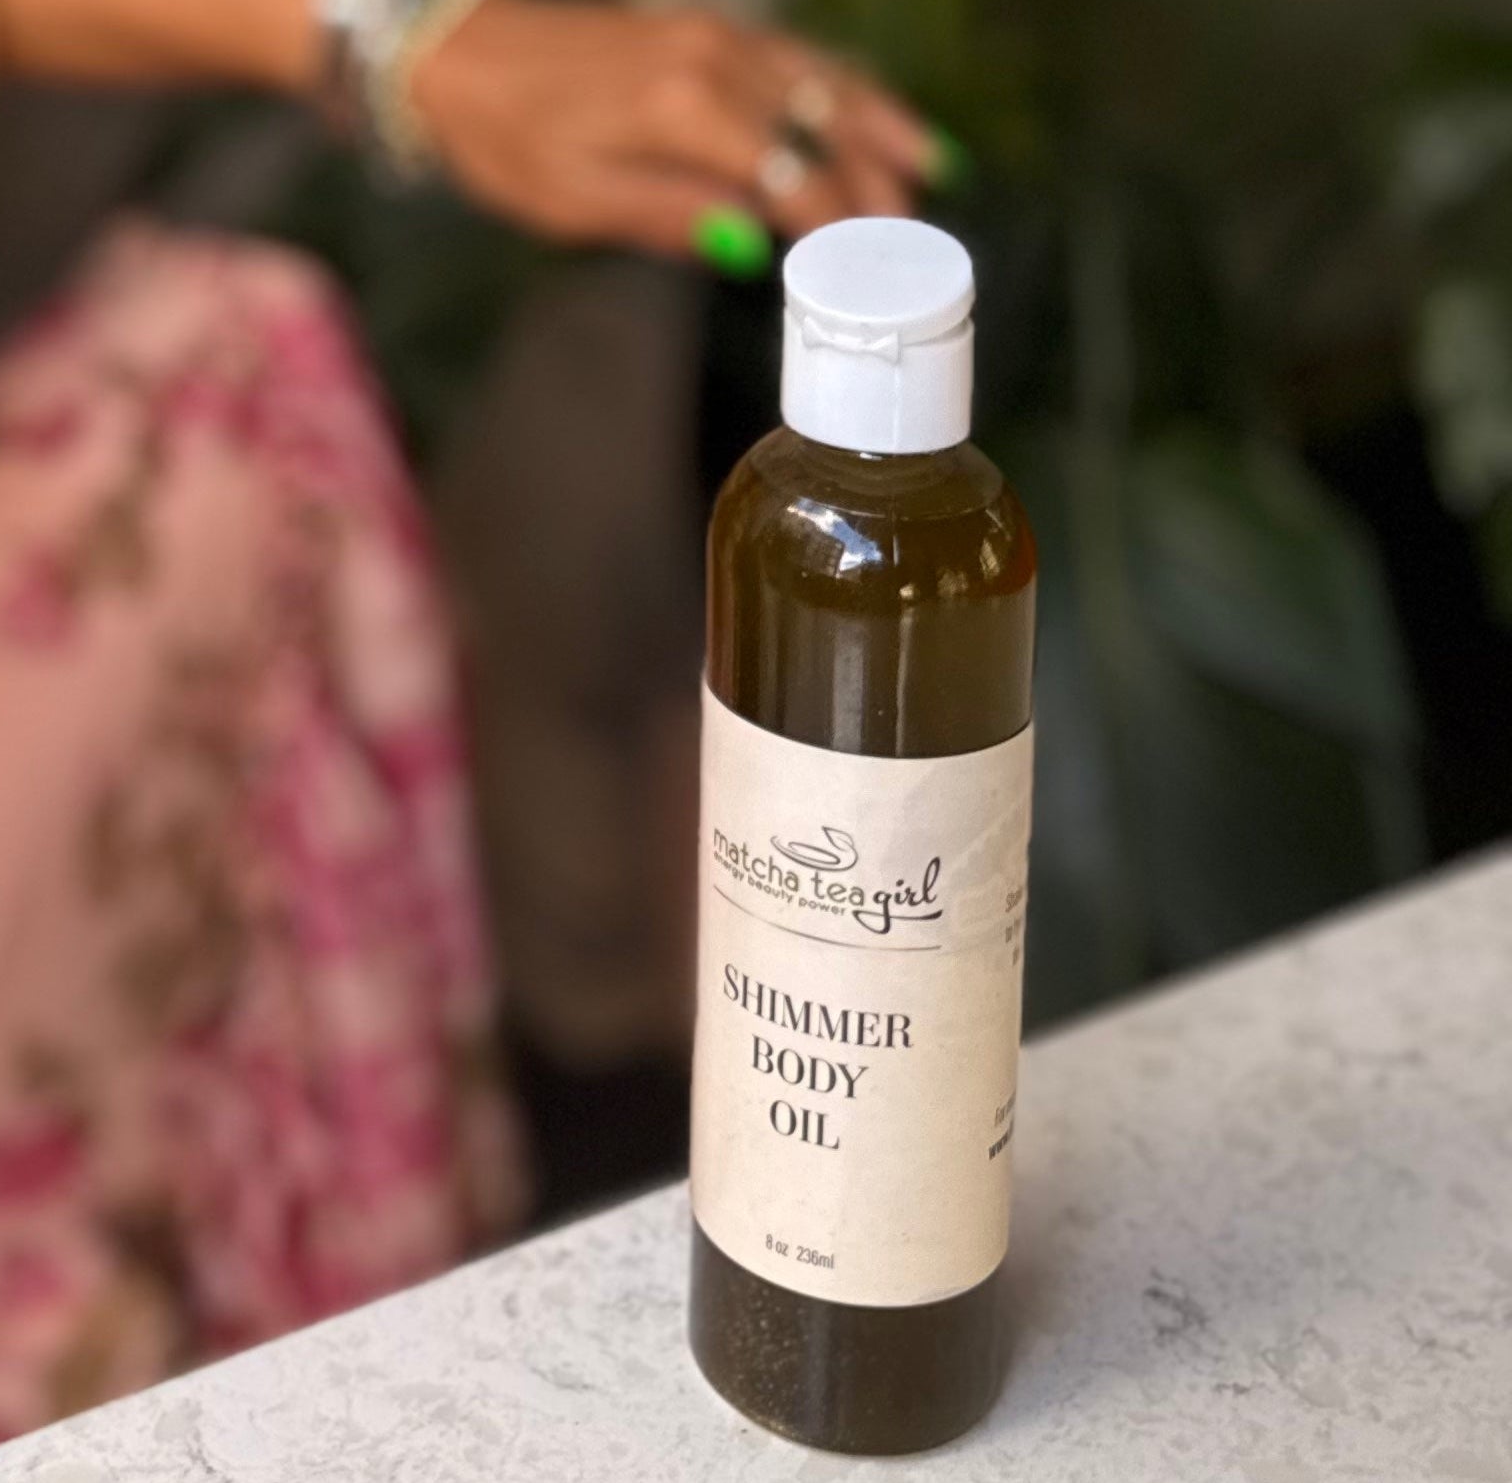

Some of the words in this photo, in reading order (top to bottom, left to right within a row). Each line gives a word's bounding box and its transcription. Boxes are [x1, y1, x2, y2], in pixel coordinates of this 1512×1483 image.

[714, 828, 799, 892] matcha
[811, 871, 865, 906] tea
[853, 856, 943, 934] girl
[714, 850, 744, 881] energy
[748, 875, 793, 903] beauty
[799, 897, 846, 915] power
[723, 963, 914, 1049] SHIMMER
[751, 1034, 869, 1099] BODY
[769, 1099, 841, 1150] OIL
[765, 1233, 773, 1250] 8
[775, 1241, 789, 1257] oz
[796, 1246, 835, 1269] 236ml
